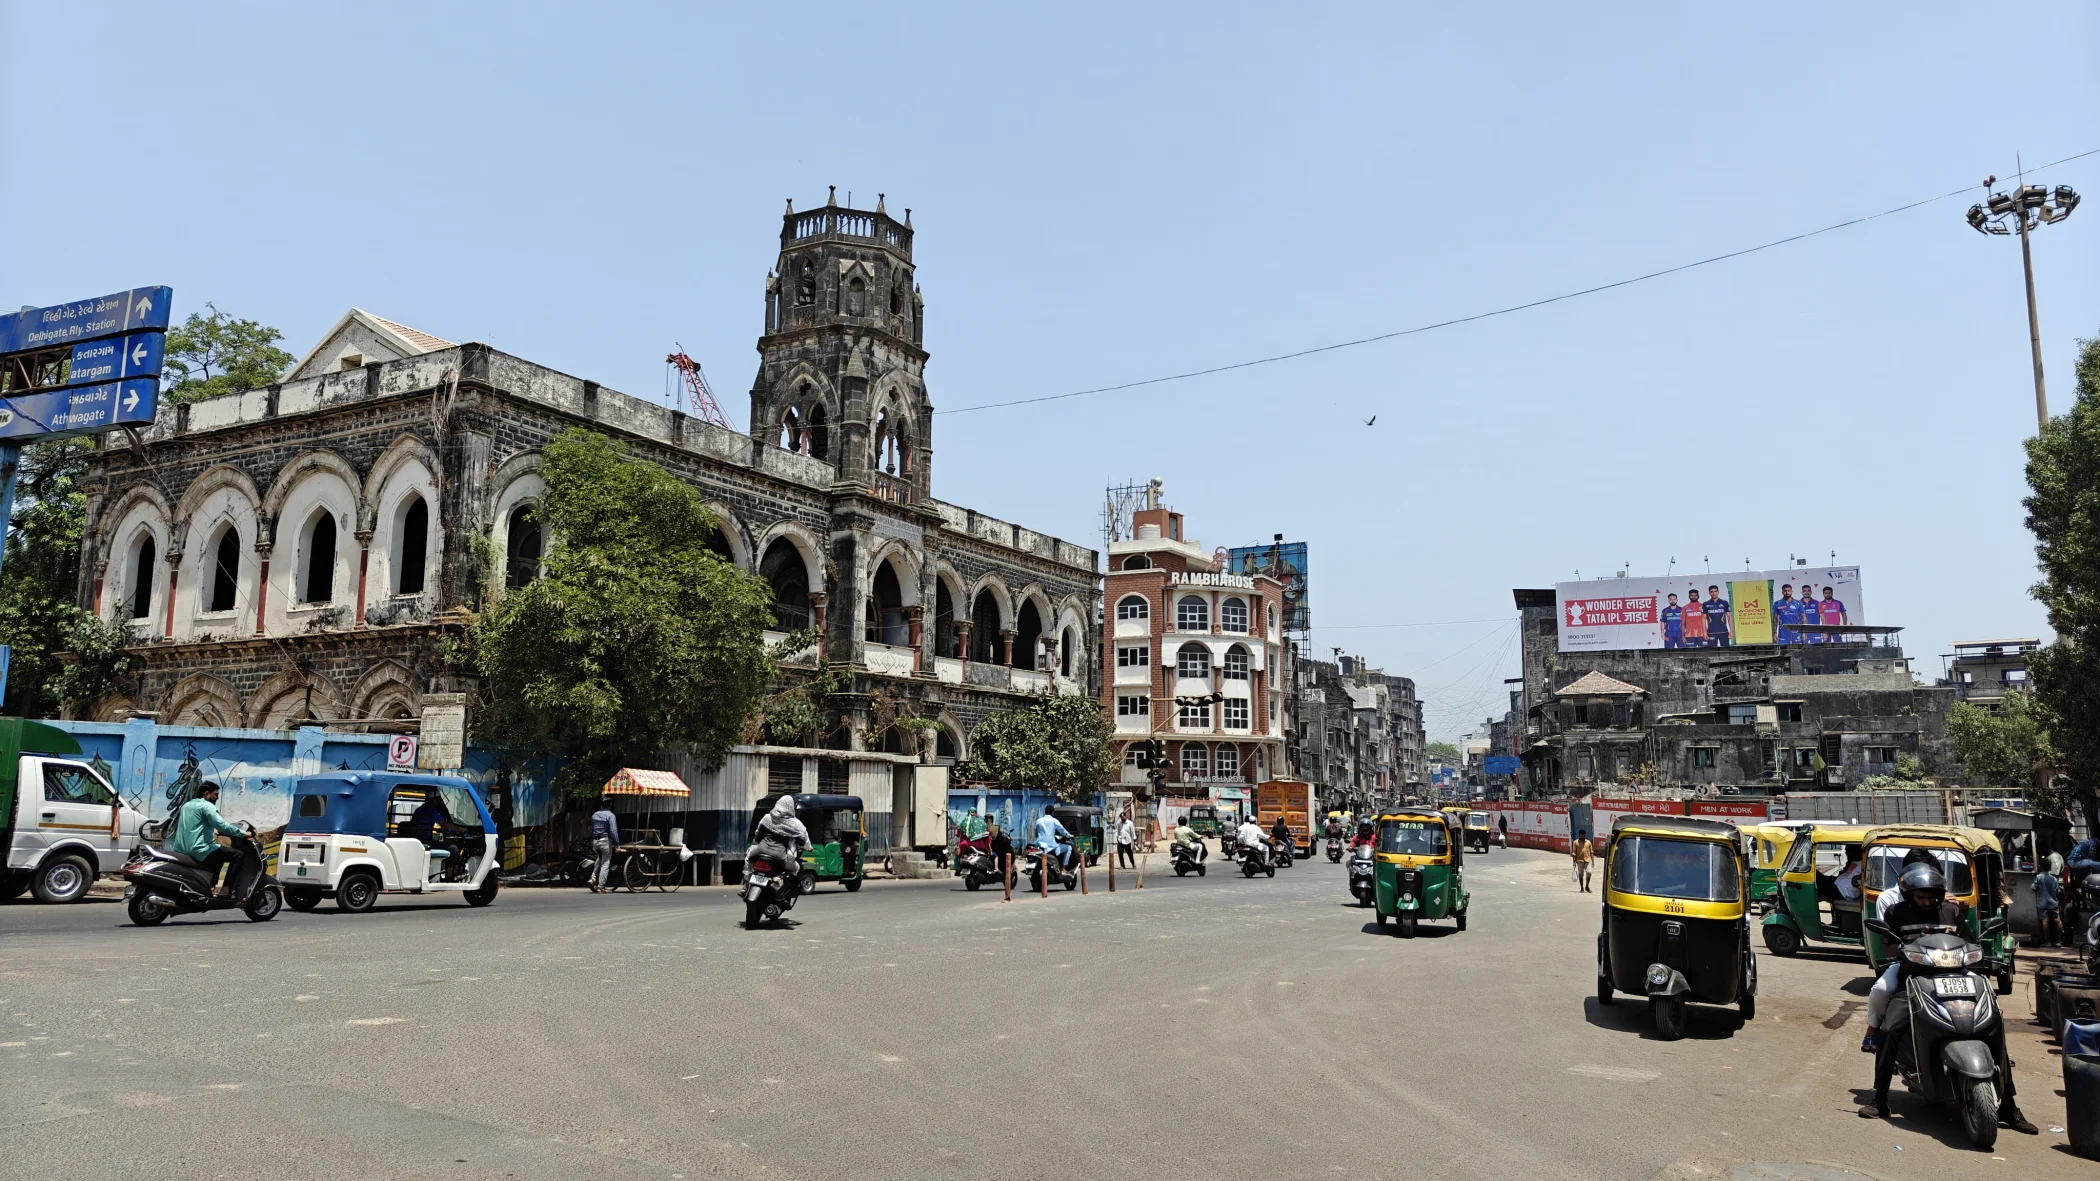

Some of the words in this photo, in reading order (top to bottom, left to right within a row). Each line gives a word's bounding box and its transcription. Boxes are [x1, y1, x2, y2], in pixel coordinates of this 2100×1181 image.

[96, 299, 119, 313] સ્ટેશન
[28, 327, 69, 342] Delhigate,
[69, 325, 84, 336] Rly.
[86, 318, 116, 333] Station
[77, 345, 114, 360] કતારગામ
[68, 388, 108, 405] અઠવાગેટ
[51, 409, 105, 426] Athwagate
[1171, 571, 1254, 590] RAMBHAROSE
[1585, 600, 1623, 611] WONDER
[1625, 598, 1652, 610] लाइए
[1586, 613, 1606, 624] TATA
[1608, 612, 1622, 623] IPL
[1622, 611, 1649, 623] जाइए
[1730, 806, 1752, 814] WORK
[1664, 904, 1685, 914] 2101
[1941, 977, 1967, 986] GJ05N
